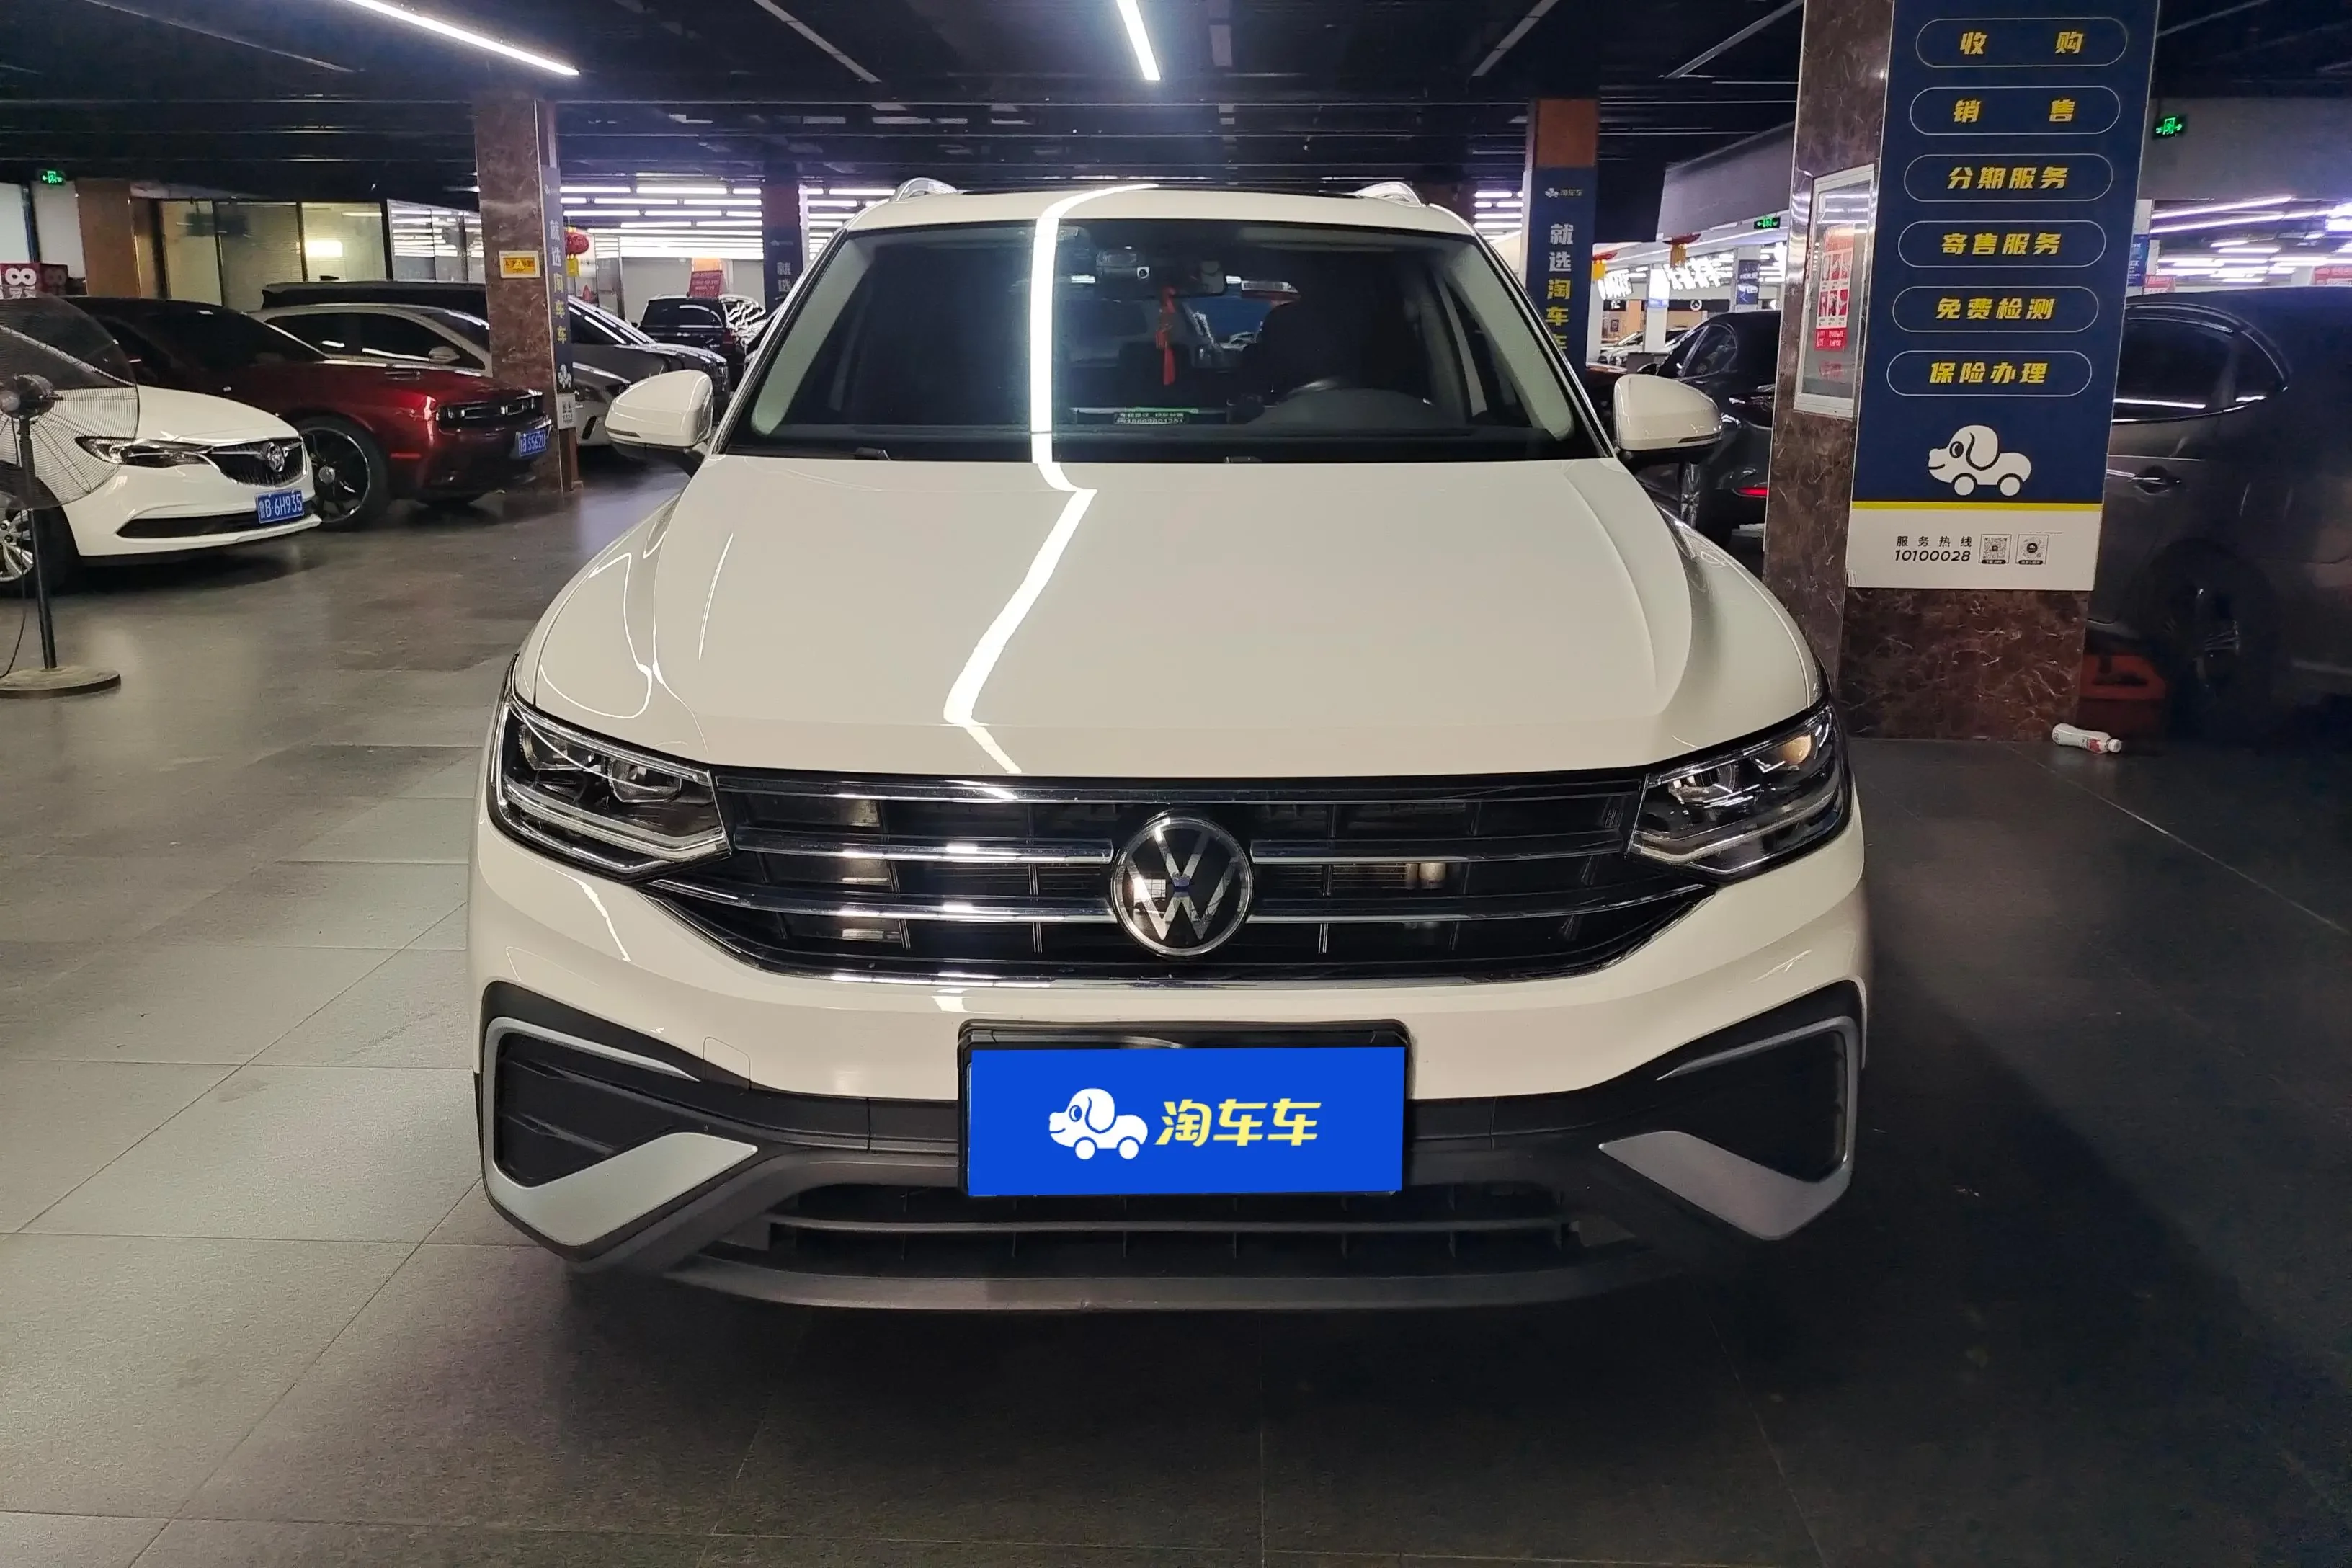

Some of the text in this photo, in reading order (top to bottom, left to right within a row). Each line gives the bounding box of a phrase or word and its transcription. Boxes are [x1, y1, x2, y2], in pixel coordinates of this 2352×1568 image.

[1947, 166, 2069, 190] 分期服务
[1941, 232, 2062, 255] 寄售服务
[1935, 297, 2056, 320] 免费检测
[1928, 362, 2048, 384] 保险办理
[1895, 535, 1972, 548] 服务热线
[1894, 549, 1972, 562] 10100028
